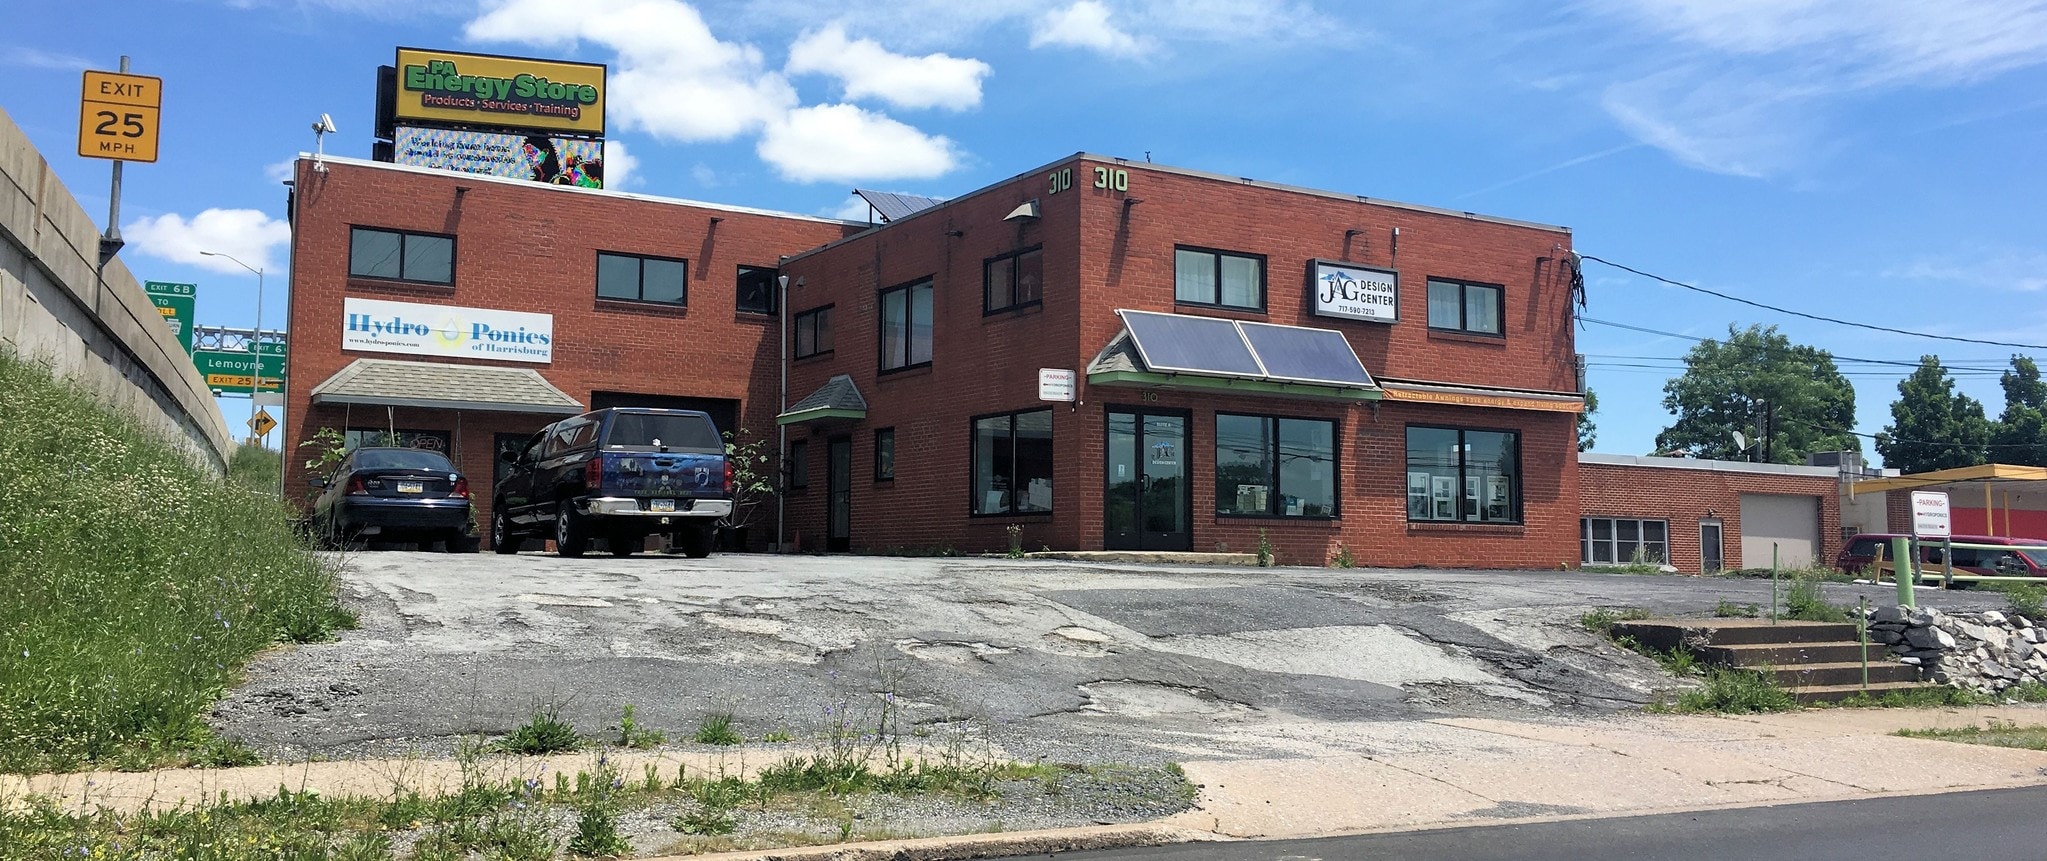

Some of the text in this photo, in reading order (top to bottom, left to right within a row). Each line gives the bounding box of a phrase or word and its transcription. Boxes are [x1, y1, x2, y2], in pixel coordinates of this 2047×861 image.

[430, 61, 456, 75] PA
[101, 81, 144, 97] EXIT
[406, 65, 597, 102] Energy Store
[424, 94, 580, 118] Products Services Training
[95, 110, 144, 138] 25
[1048, 167, 1072, 195] 310
[1094, 166, 1128, 192] 310
[1320, 275, 1360, 304] JAG
[1360, 280, 1393, 294] DESIGN
[157, 298, 169, 306] TO
[1360, 293, 1394, 306] CENTER
[1338, 305, 1375, 316] 717-590-7213
[348, 313, 551, 345] Hydro Ponies
[471, 343, 549, 357] of Harrisburg
[208, 359, 265, 371] Lemoyne
[213, 376, 233, 384] EXIT
[237, 377, 252, 385] 25
[1142, 392, 1158, 402] 310
[1435, 394, 1464, 403] Awnings
[410, 437, 443, 449] OPEN
